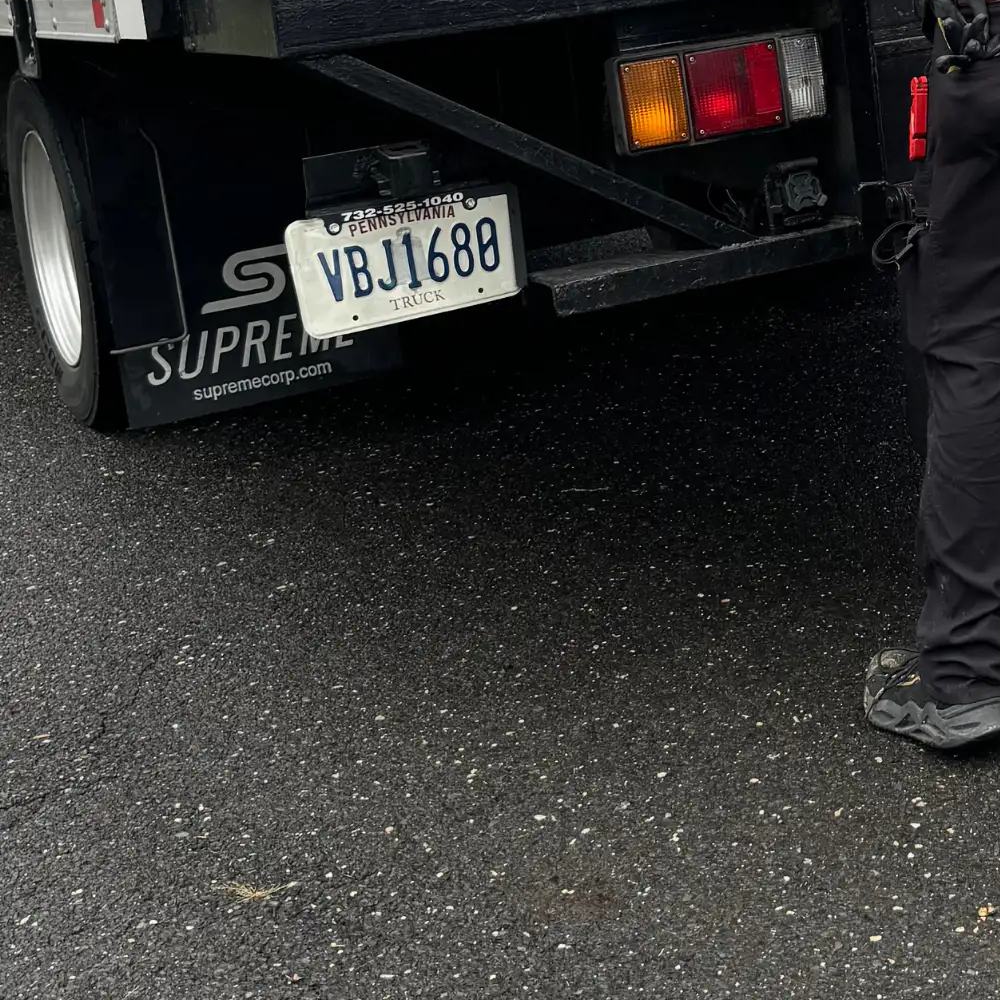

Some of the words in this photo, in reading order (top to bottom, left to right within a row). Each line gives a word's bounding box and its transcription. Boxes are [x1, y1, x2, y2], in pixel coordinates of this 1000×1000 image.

[341, 192, 464, 222] 732-525-1040
[348, 205, 455, 237] PENNSYLVANIA
[317, 217, 500, 302] VBJ1680
[389, 289, 446, 311] TRUCK
[147, 313, 354, 386] SUPRE
[193, 360, 333, 401] supremecorp.com
